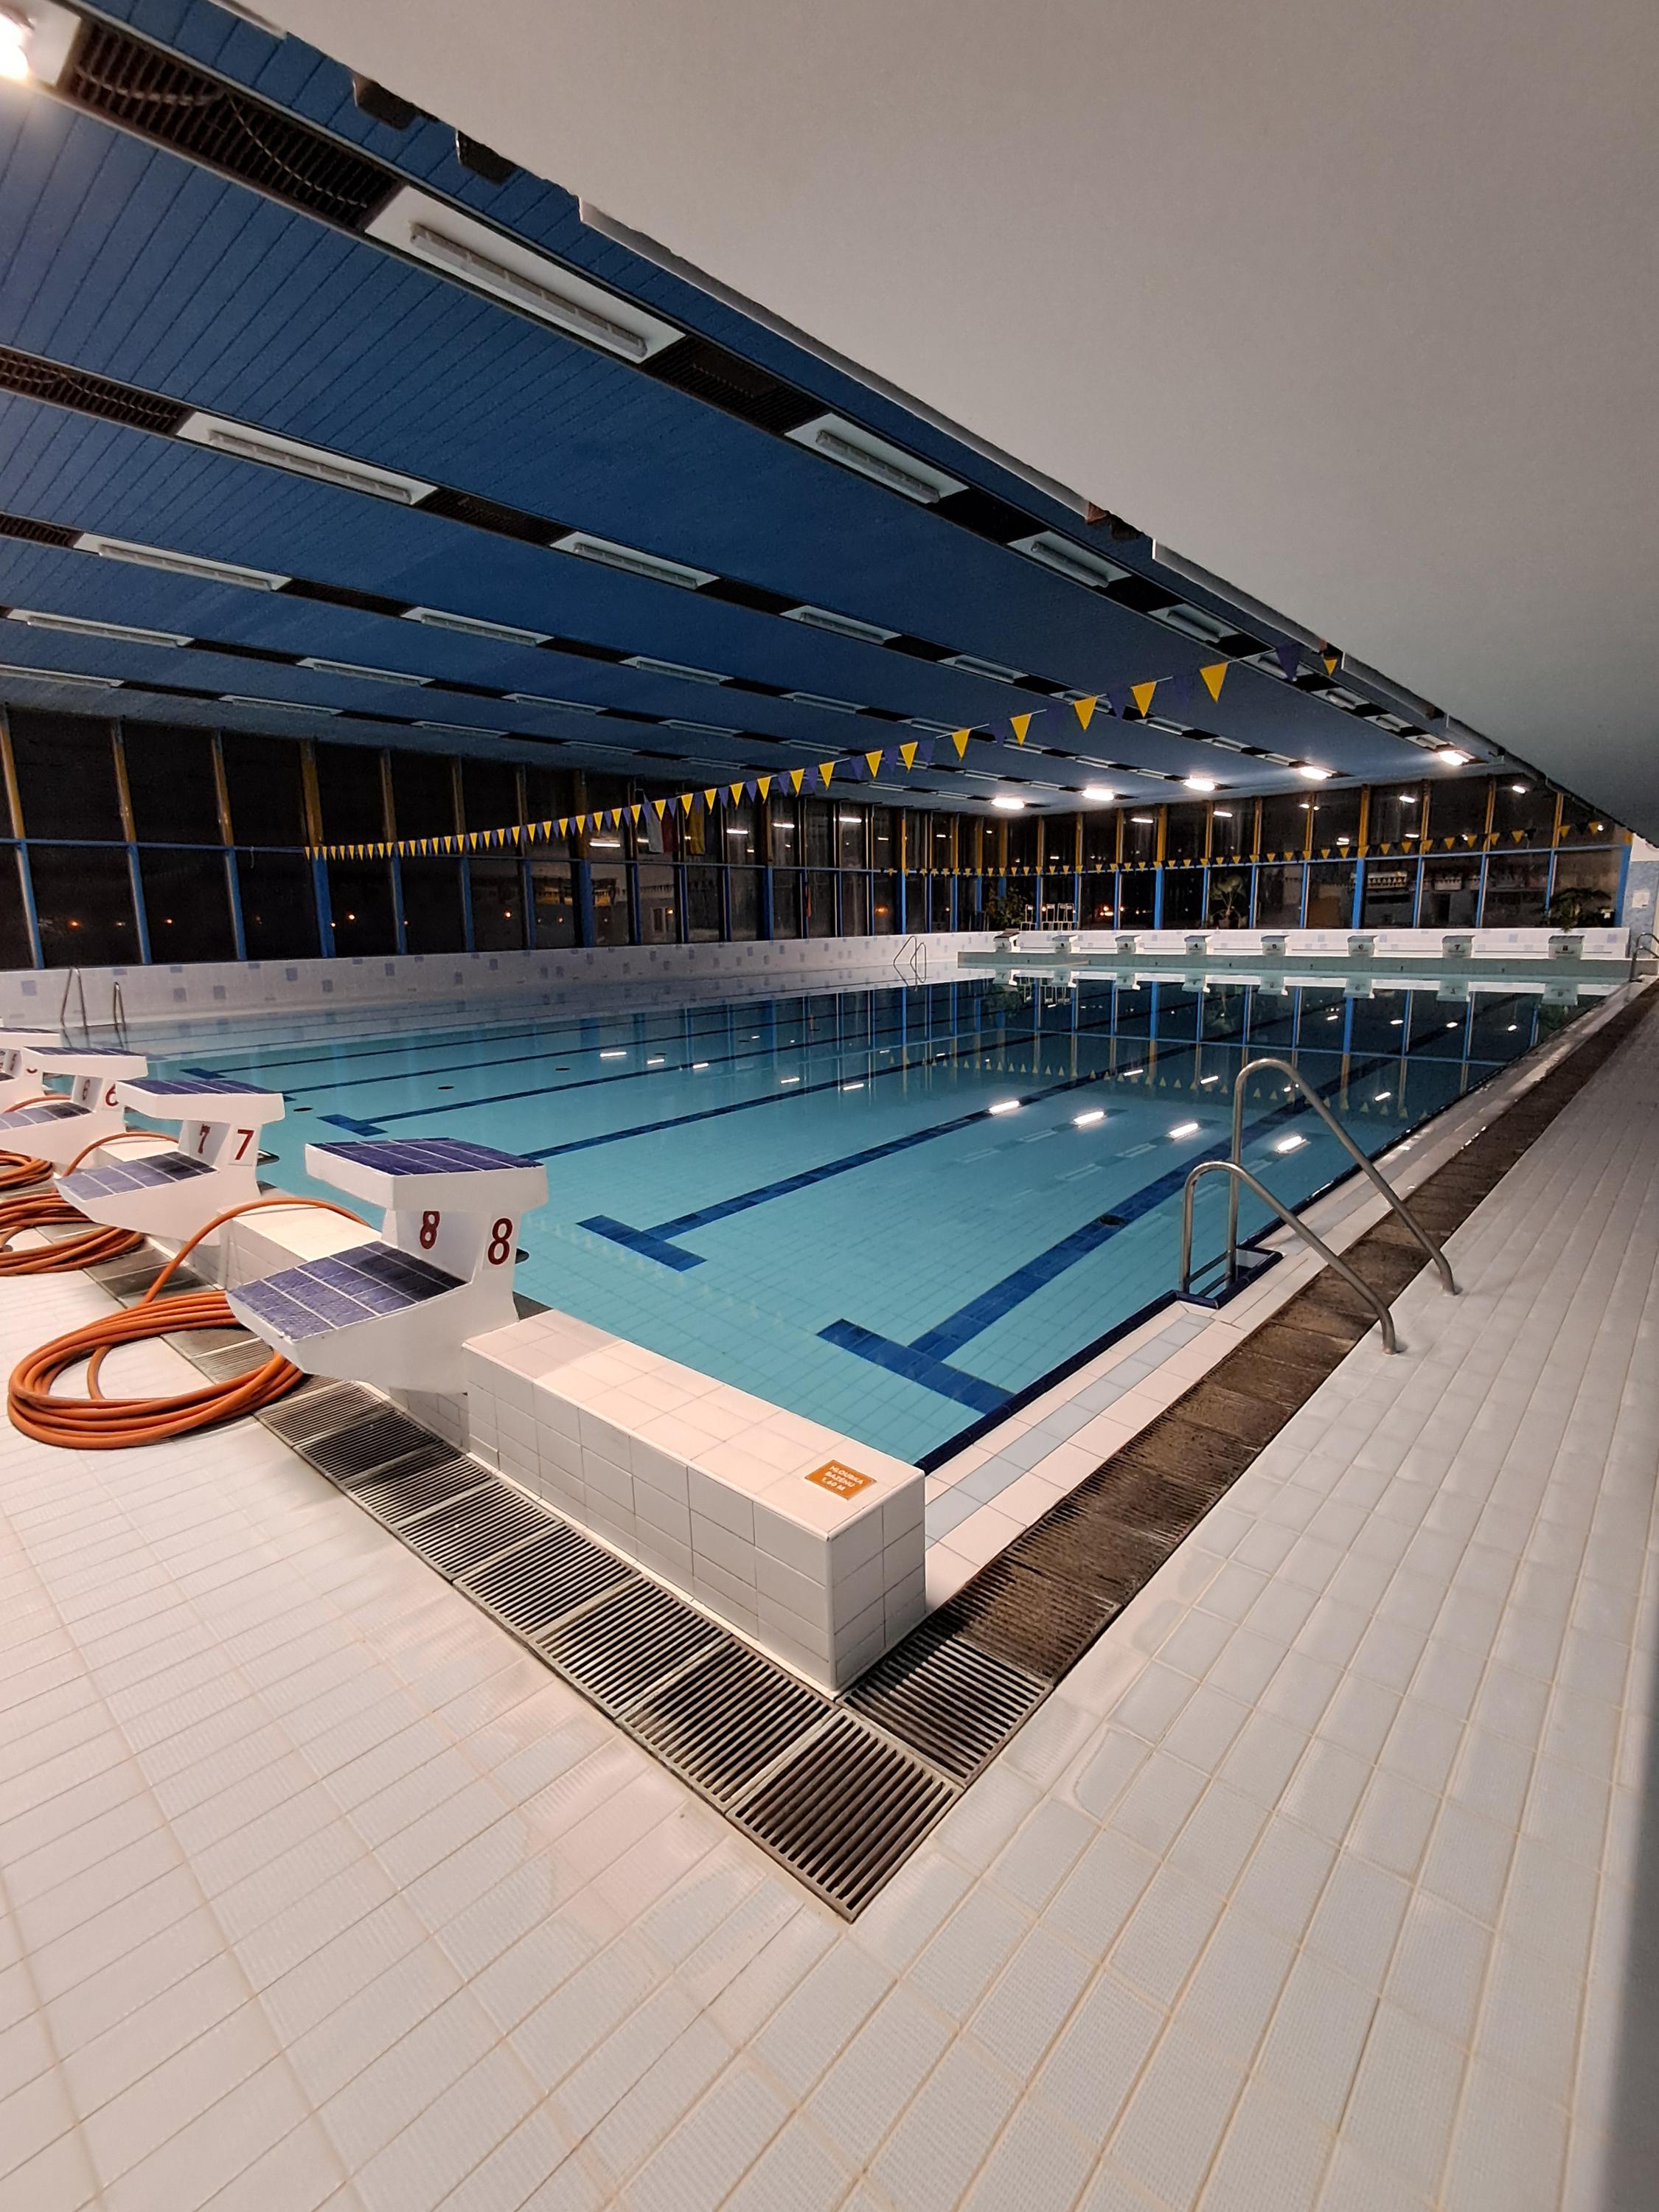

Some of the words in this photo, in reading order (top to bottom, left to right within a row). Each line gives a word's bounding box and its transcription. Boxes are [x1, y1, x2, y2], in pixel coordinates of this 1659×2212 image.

[105, 1084, 119, 1106] 6
[198, 1124, 211, 1154] 7
[235, 1129, 254, 1161] 7
[420, 1211, 440, 1250] 8
[487, 1217, 513, 1265] 8
